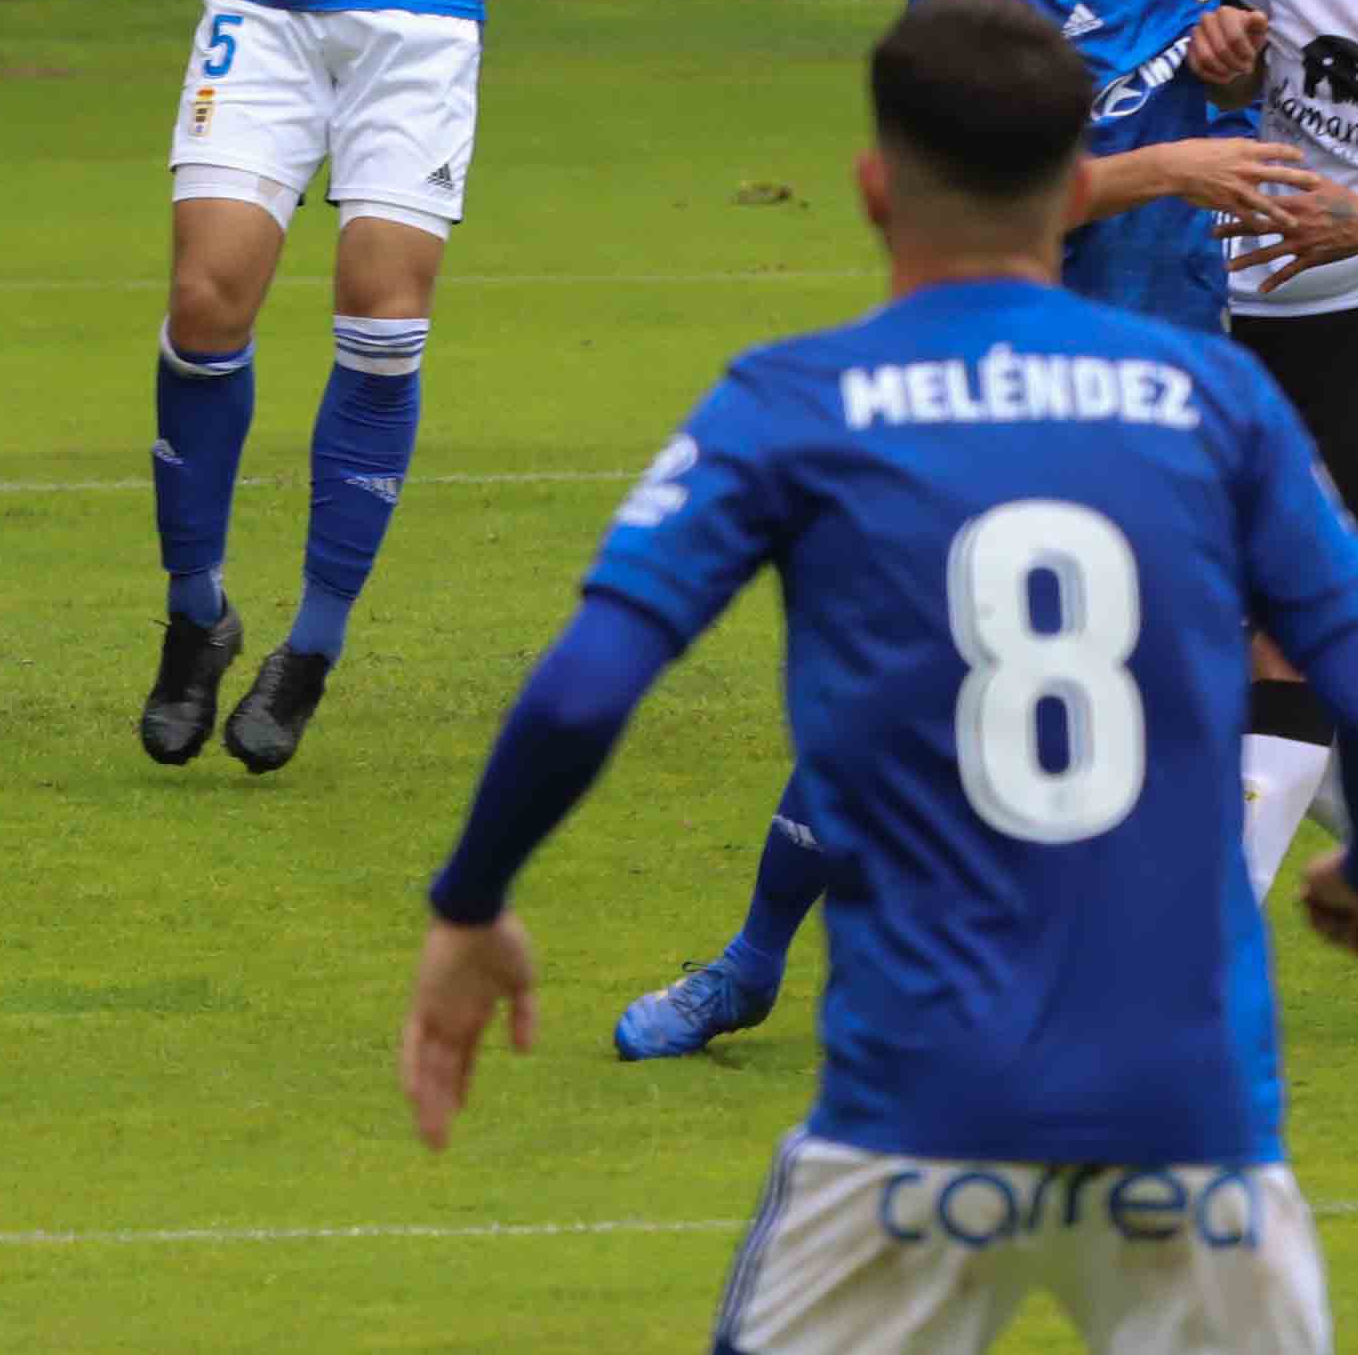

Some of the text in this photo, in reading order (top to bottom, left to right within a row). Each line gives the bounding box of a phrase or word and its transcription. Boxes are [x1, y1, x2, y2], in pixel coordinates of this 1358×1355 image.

[202, 14, 245, 79] 5
[839, 341, 1202, 432] MELÉNDEZ
[947, 499, 1148, 845] 8
[879, 1166, 1262, 1252] correa
